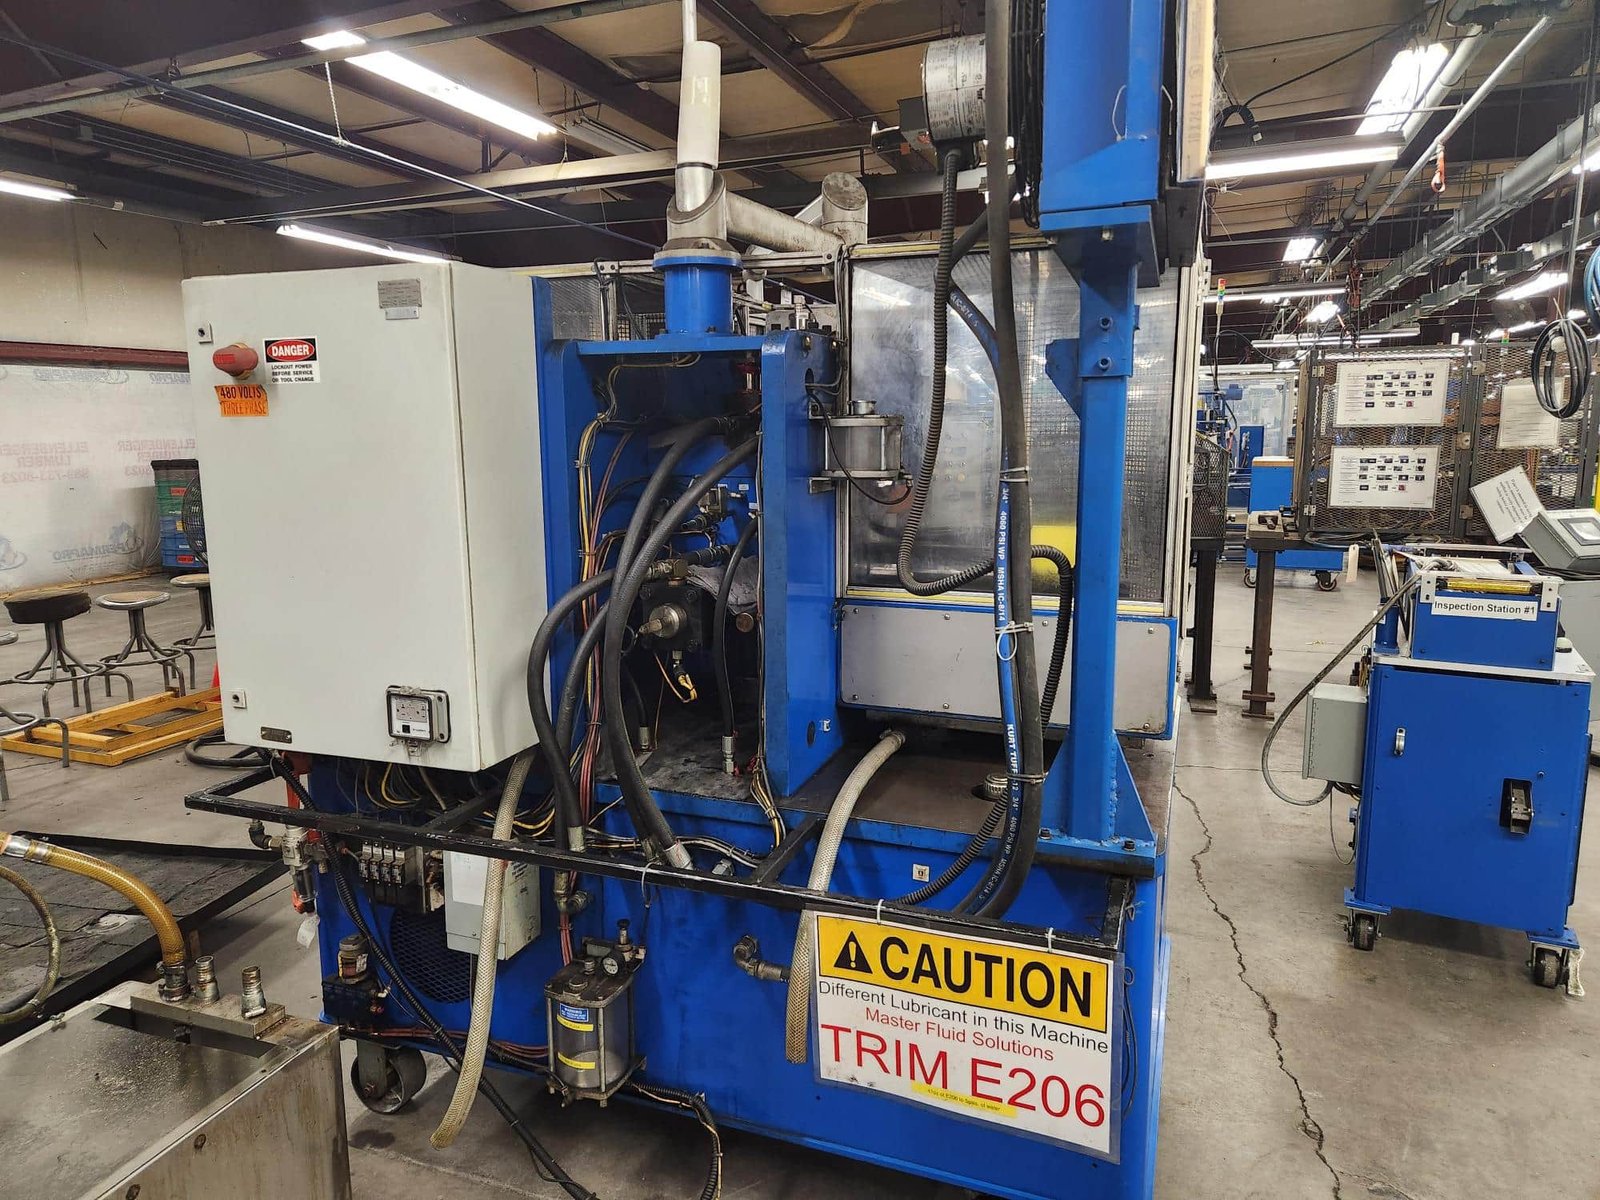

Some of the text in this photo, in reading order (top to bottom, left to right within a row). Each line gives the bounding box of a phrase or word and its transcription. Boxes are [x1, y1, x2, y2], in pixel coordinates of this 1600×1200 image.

[271, 345, 310, 357] DANGER
[220, 386, 262, 399] 480 VOLTS
[222, 401, 267, 415] THREE PHASE
[999, 531, 1007, 545] PSI
[999, 546, 1006, 560] WP
[997, 567, 1005, 592] MSHA
[1434, 600, 1535, 614] Inspection Station #1
[1006, 723, 1015, 749] KURT
[1007, 833, 1015, 844] PSI
[1004, 844, 1012, 855] WP
[879, 936, 1091, 1018] CAUTION
[818, 980, 1109, 1054] Different Lubricant in this Machine
[865, 1007, 1054, 1062] Master Fluid Solutions
[820, 1023, 1105, 1128] TRIM E206
